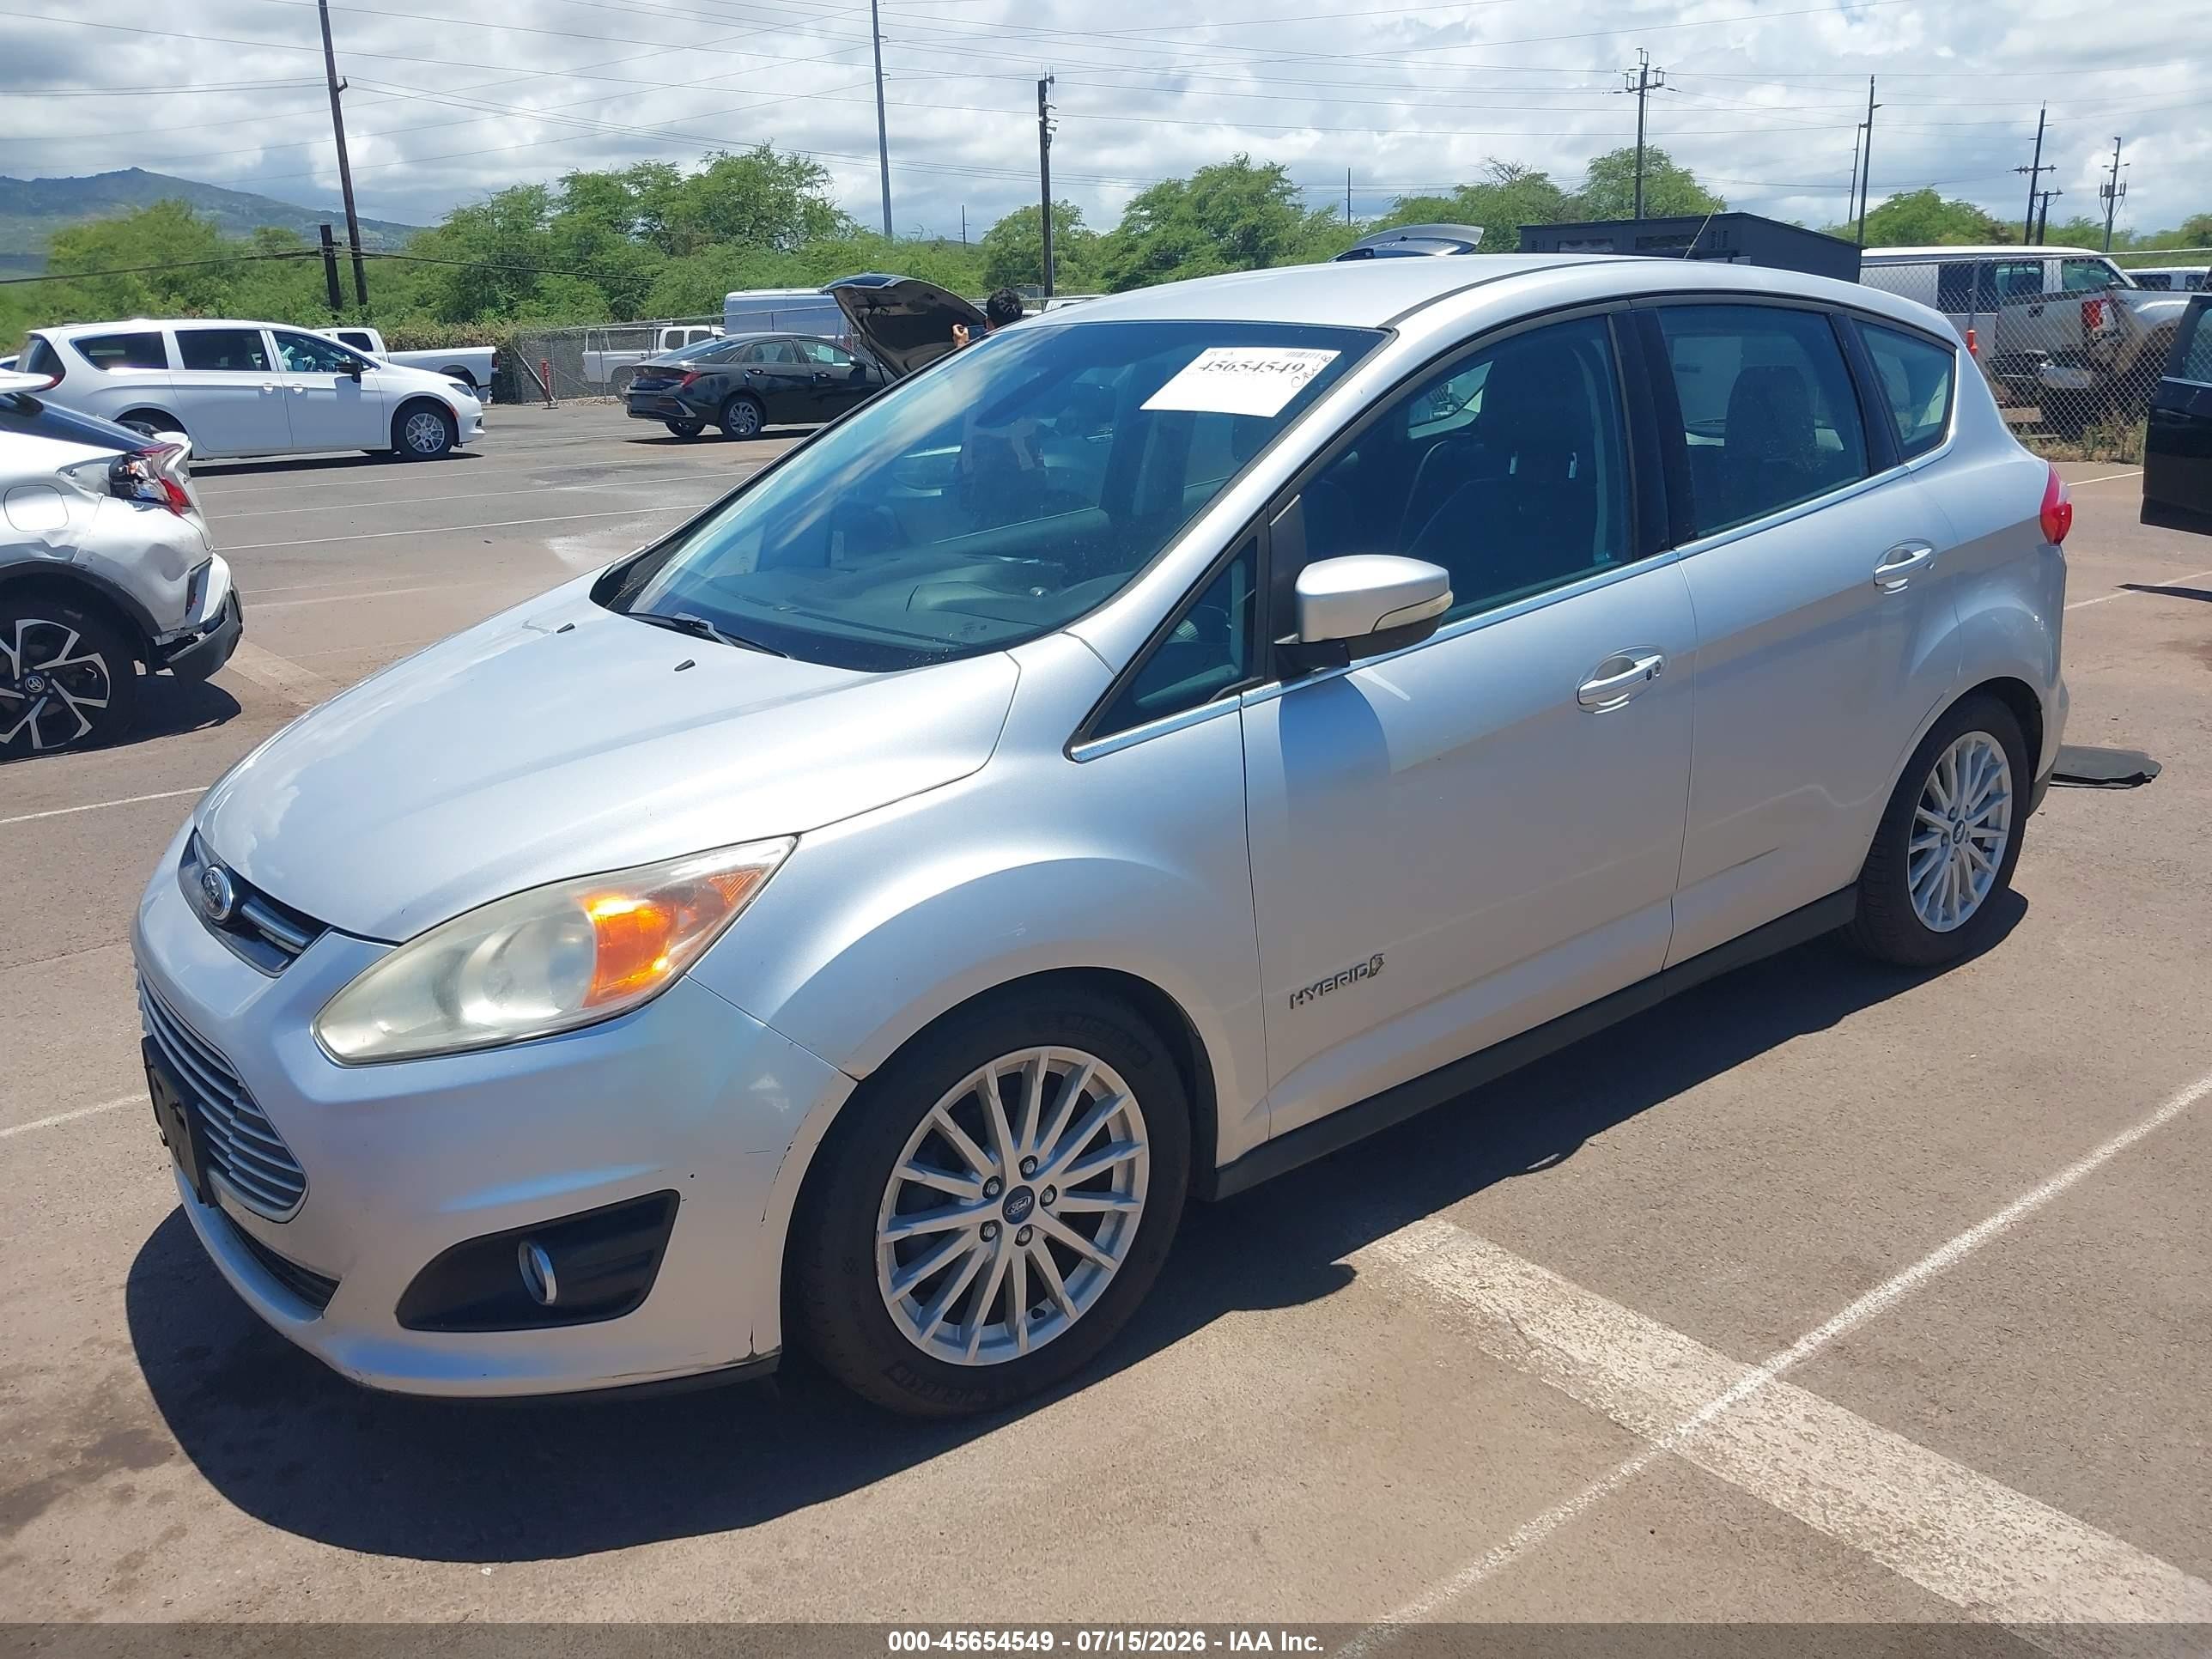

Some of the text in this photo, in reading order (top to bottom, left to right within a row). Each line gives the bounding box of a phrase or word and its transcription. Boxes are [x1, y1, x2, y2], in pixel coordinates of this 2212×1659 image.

[1198, 360, 1305, 374] 45654549
[1290, 963, 1369, 1010] HYBRID
[1009, 1196, 1031, 1213] Ford
